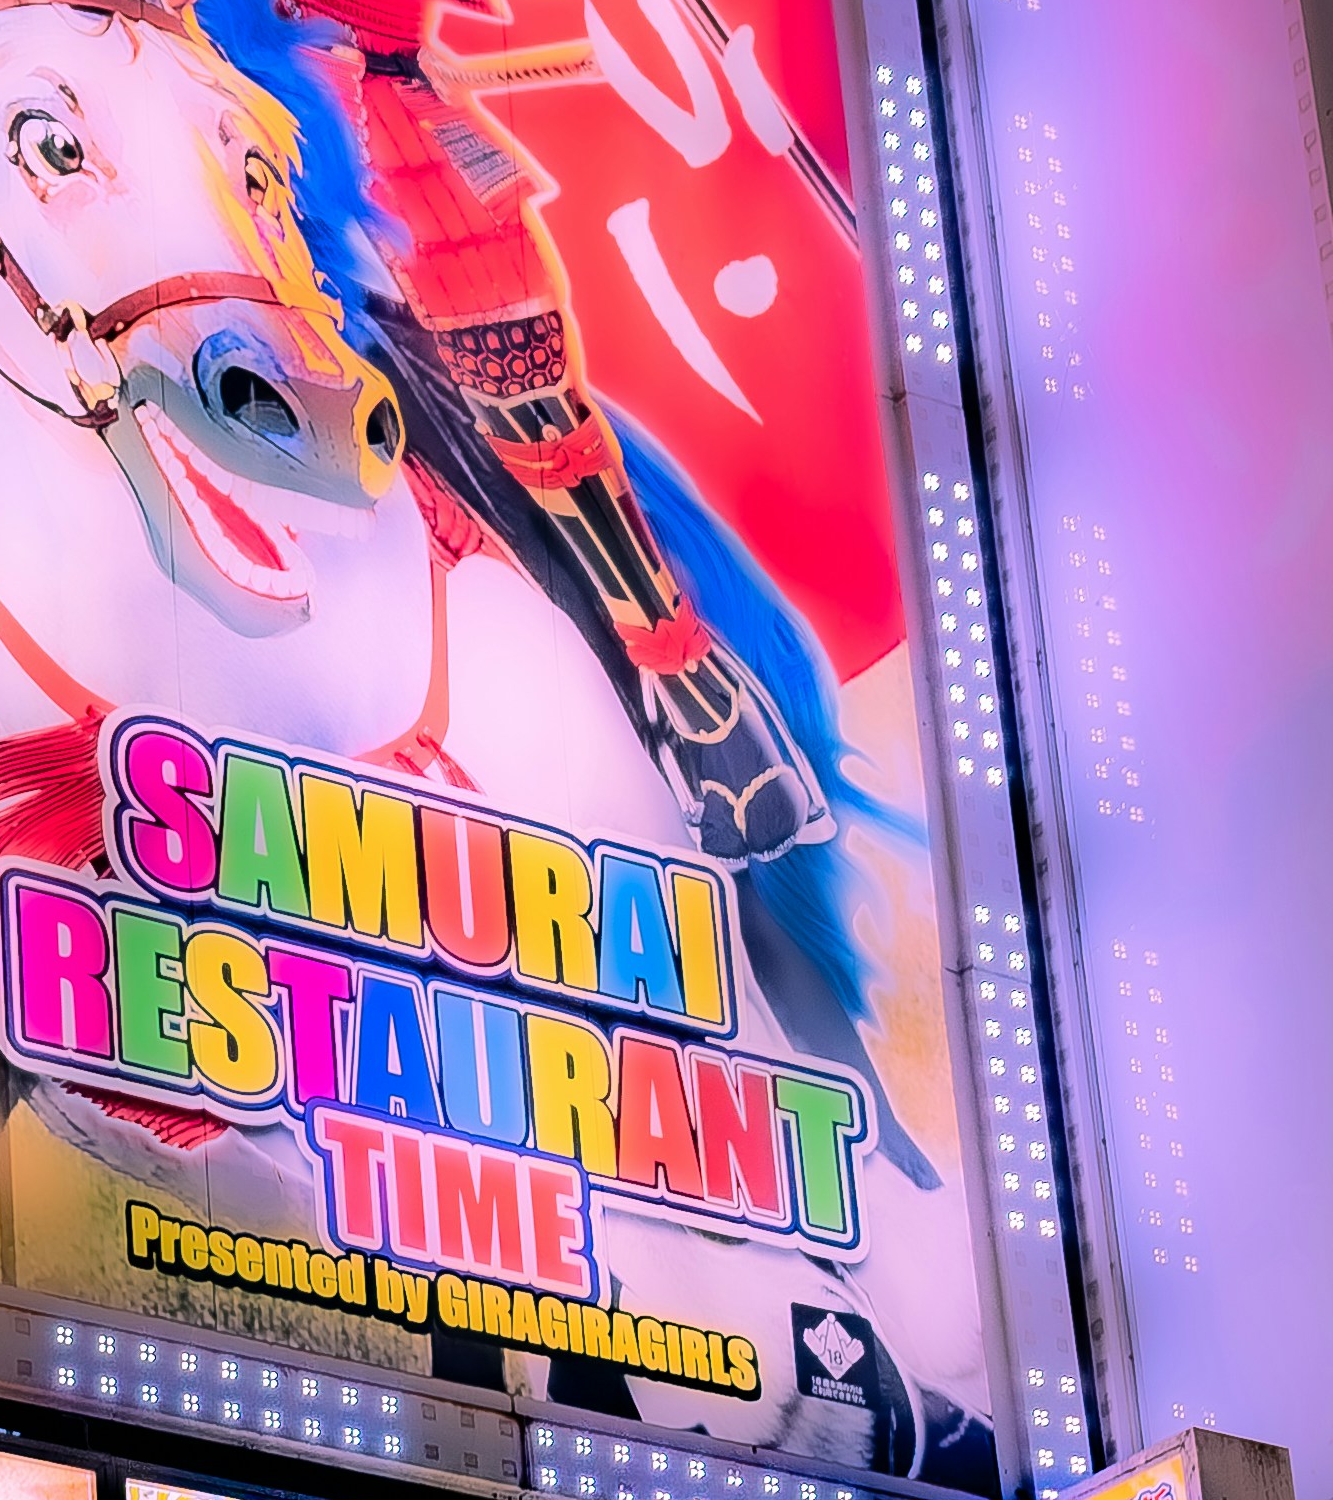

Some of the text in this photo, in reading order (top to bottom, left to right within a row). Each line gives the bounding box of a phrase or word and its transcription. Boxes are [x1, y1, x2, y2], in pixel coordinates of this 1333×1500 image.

[110, 720, 735, 1035] SAMURAI
[1, 862, 873, 1255] RESTAURANT
[128, 1202, 760, 1396] Presented by GIRAGIRAGIRLS
[308, 1102, 601, 1300] TIME
